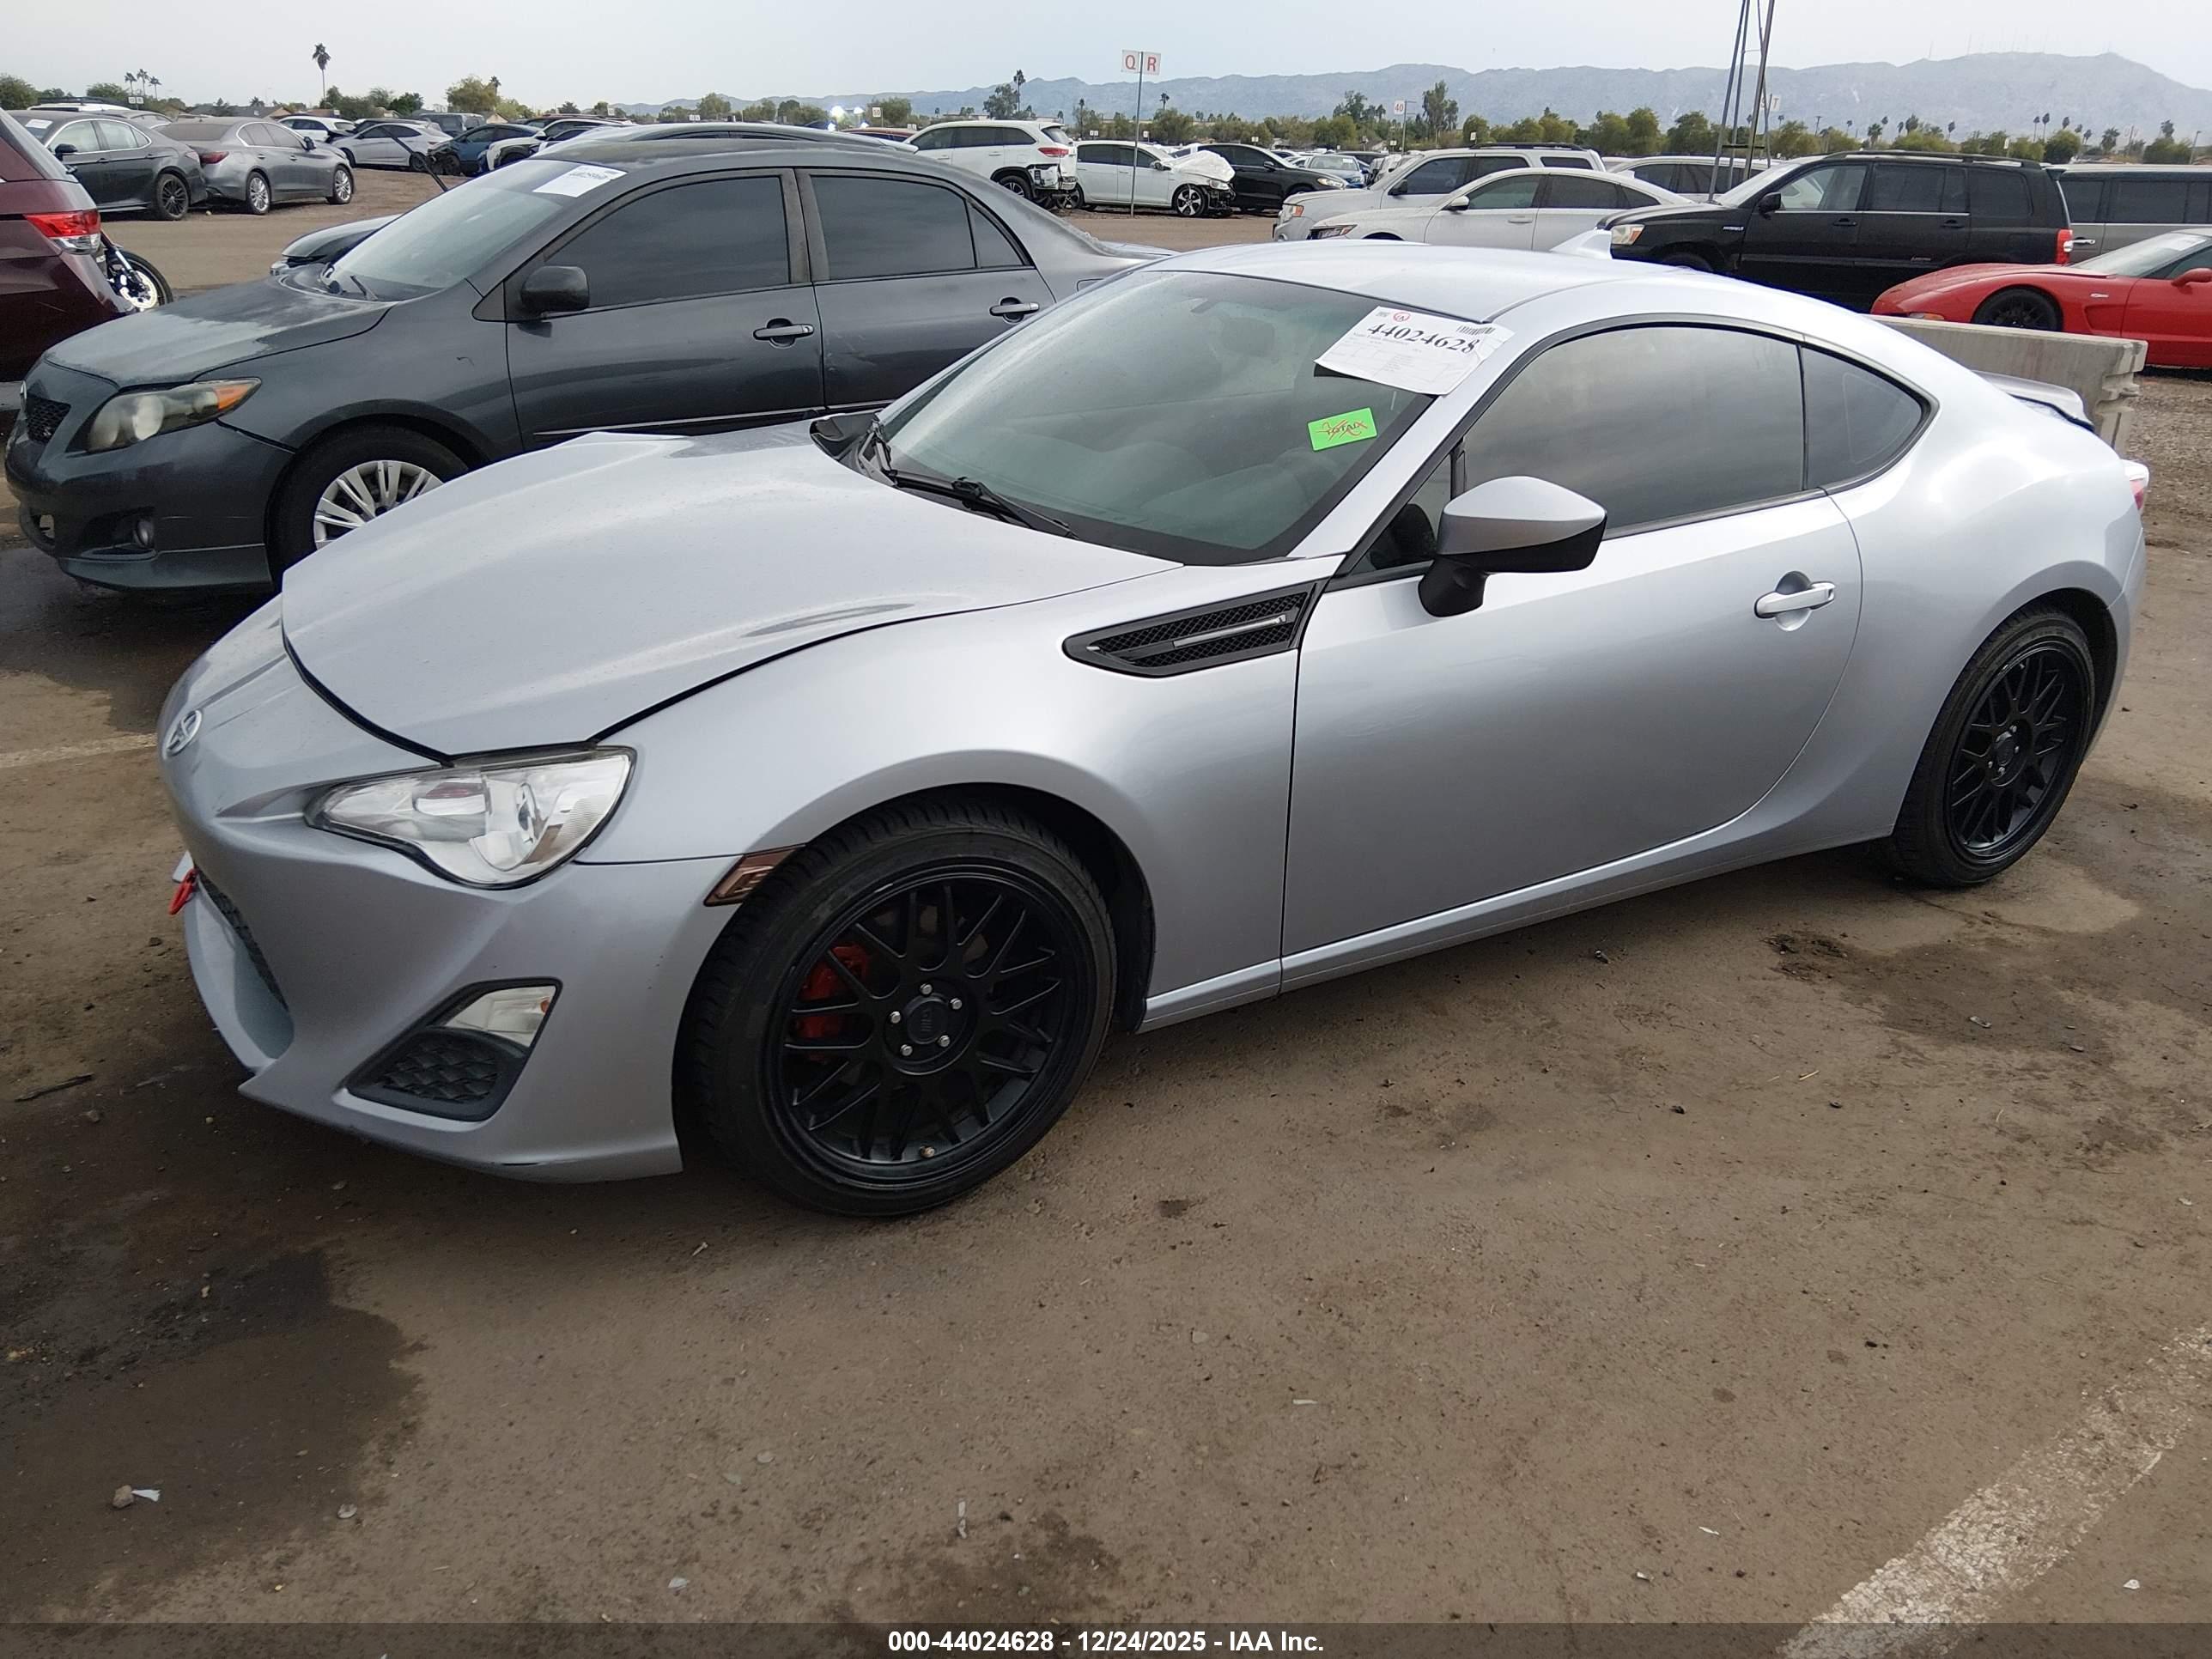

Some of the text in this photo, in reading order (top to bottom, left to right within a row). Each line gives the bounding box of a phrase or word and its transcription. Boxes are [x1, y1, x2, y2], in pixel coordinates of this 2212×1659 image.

[1125, 54, 1157, 72] Q R
[1368, 324, 1480, 354] 44024628
